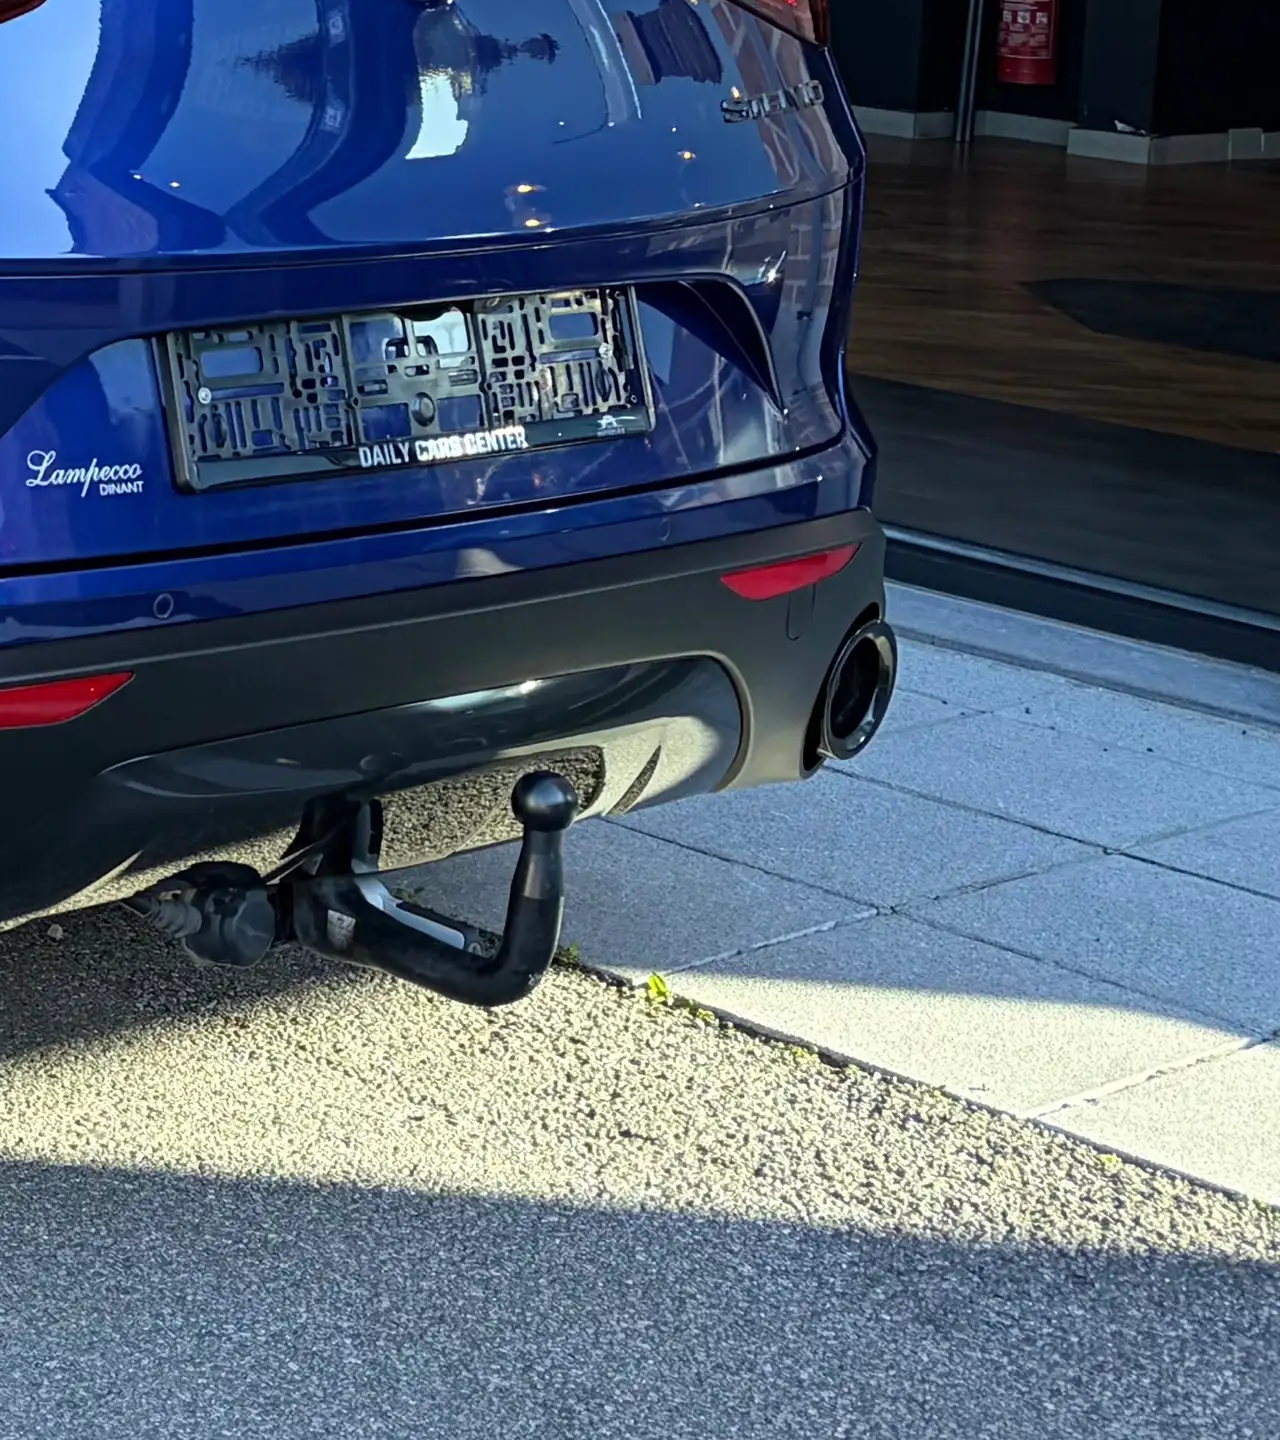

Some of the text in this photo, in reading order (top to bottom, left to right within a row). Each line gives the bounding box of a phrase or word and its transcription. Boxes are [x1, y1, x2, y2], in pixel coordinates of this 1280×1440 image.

[359, 424, 528, 469] DAILY CARS CENTER
[26, 450, 143, 498] Lampecco
[99, 480, 144, 497] DINANT
